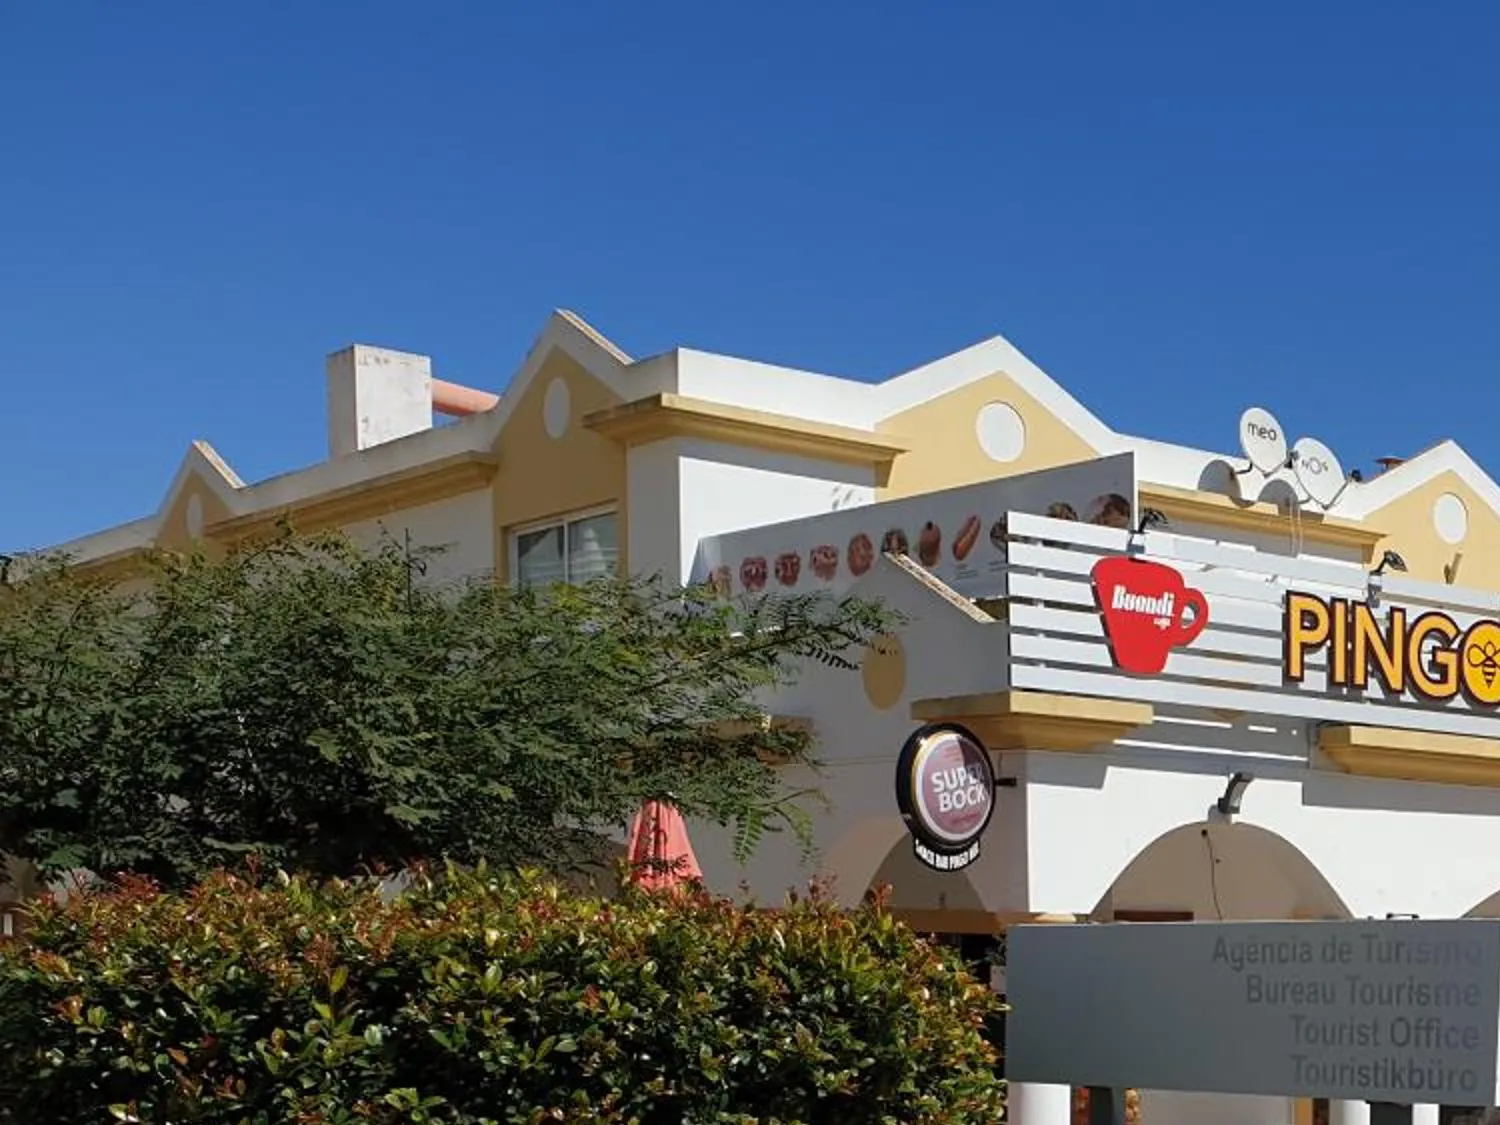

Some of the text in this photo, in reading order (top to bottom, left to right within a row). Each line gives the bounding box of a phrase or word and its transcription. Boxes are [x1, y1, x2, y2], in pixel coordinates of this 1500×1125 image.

[1247, 422, 1277, 441] meo
[938, 784, 986, 813] BOCK
[1211, 934, 1482, 972] Agência de Turismo
[1246, 974, 1481, 1008] Bureau Tourisme
[1289, 1015, 1481, 1051] Tourist Office
[1289, 1056, 1478, 1092] Touristikbüro
